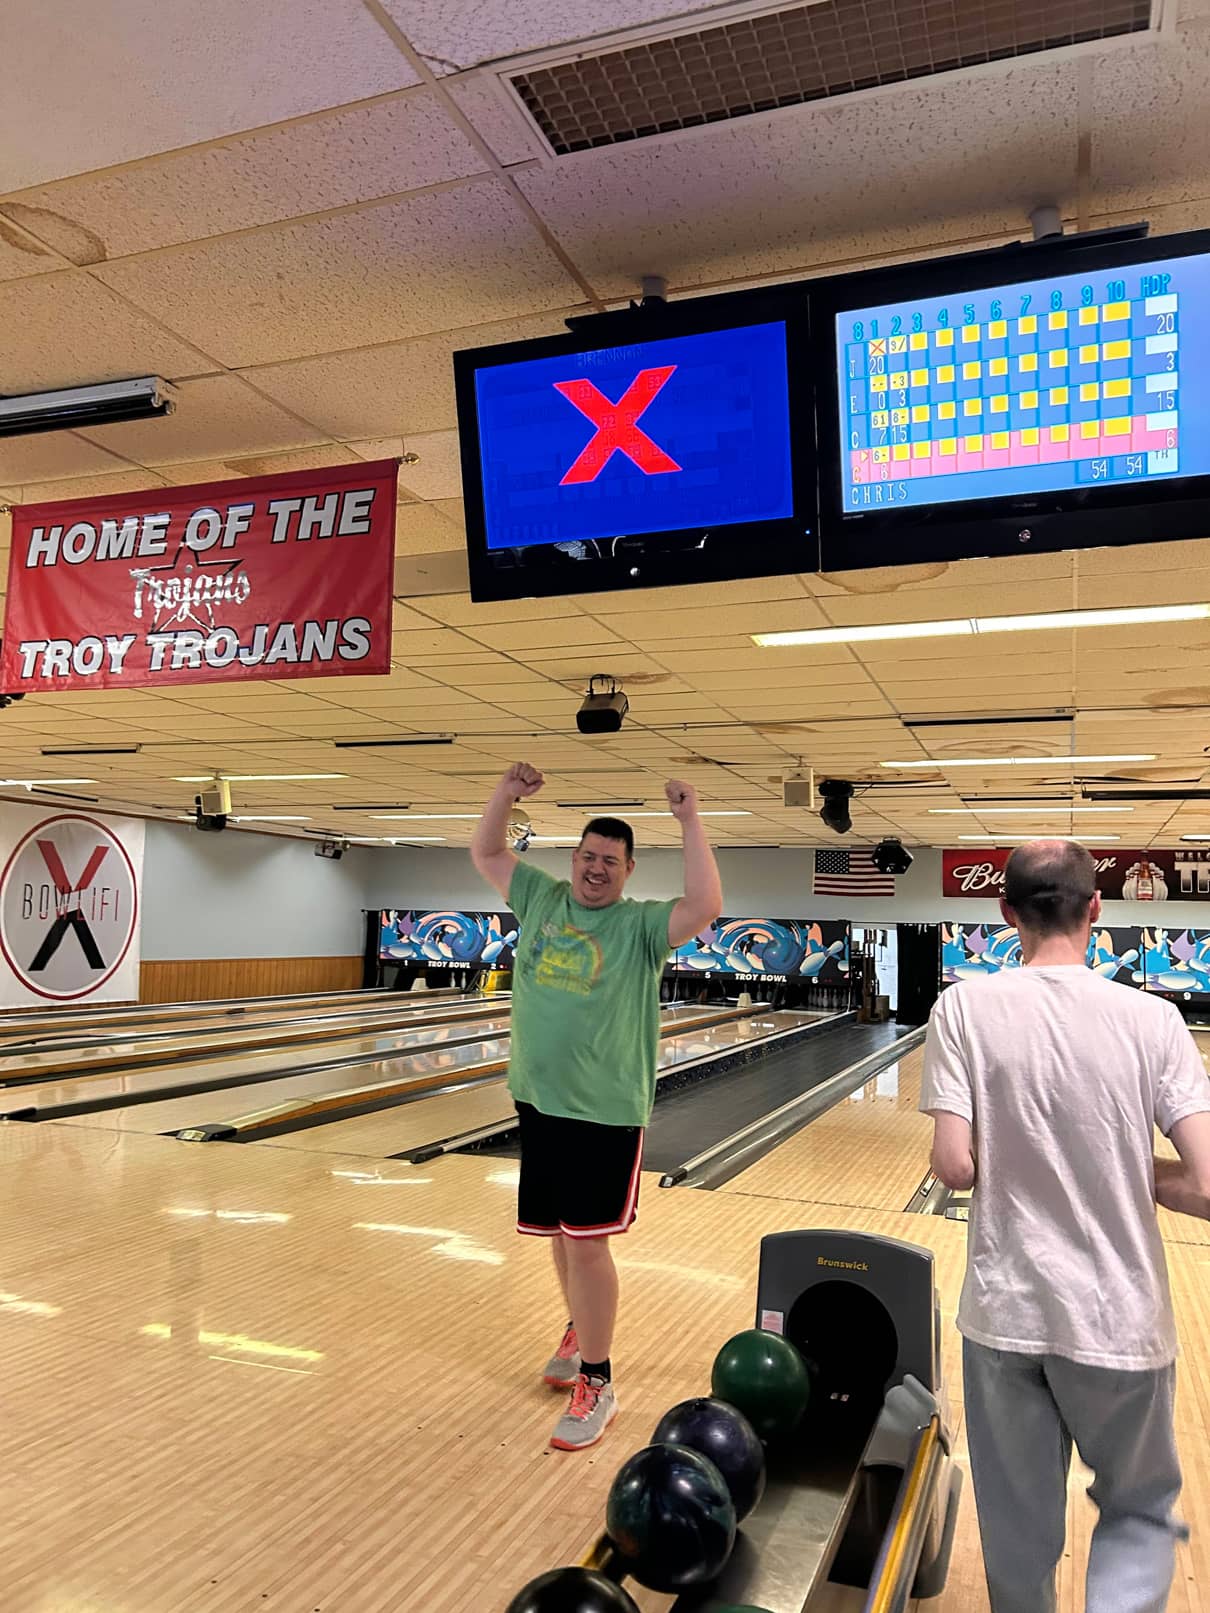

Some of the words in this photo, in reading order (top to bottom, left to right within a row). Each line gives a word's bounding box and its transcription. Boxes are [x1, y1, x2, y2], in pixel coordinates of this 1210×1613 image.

[853, 321, 864, 341] 8
[871, 319, 878, 338] 1
[891, 316, 902, 336] 2
[912, 312, 922, 332] 3
[938, 308, 948, 328] 4
[964, 304, 975, 324] 5
[991, 300, 1002, 320] 6
[1020, 295, 1031, 316] 7
[1051, 290, 1062, 311] 8
[1081, 285, 1093, 305] 9
[1106, 280, 1126, 301] 10
[1140, 273, 1171, 297] HDP
[870, 356, 885, 375] 20
[1157, 313, 1175, 334] 20
[899, 389, 906, 407] 3
[1166, 352, 1175, 371] 3
[851, 431, 859, 449] C
[879, 427, 887, 446] 7
[891, 425, 907, 444] 15
[1157, 391, 1175, 411] 15
[1166, 429, 1175, 448] 6
[851, 482, 908, 505] CHRIS
[1091, 459, 1107, 479] 54
[1126, 456, 1143, 476] 54
[25, 512, 172, 568] HOME
[184, 502, 256, 552] OF
[268, 488, 377, 544] THE
[19, 634, 136, 678] TROY
[145, 616, 373, 675] TROJANS
[428, 960, 448, 968] TROY
[448, 961, 471, 969] BOWL
[735, 973, 759, 982] TROY
[760, 974, 788, 983] BOWL
[1183, 991, 1191, 1001] 9
[817, 1256, 869, 1271] Brunswick
